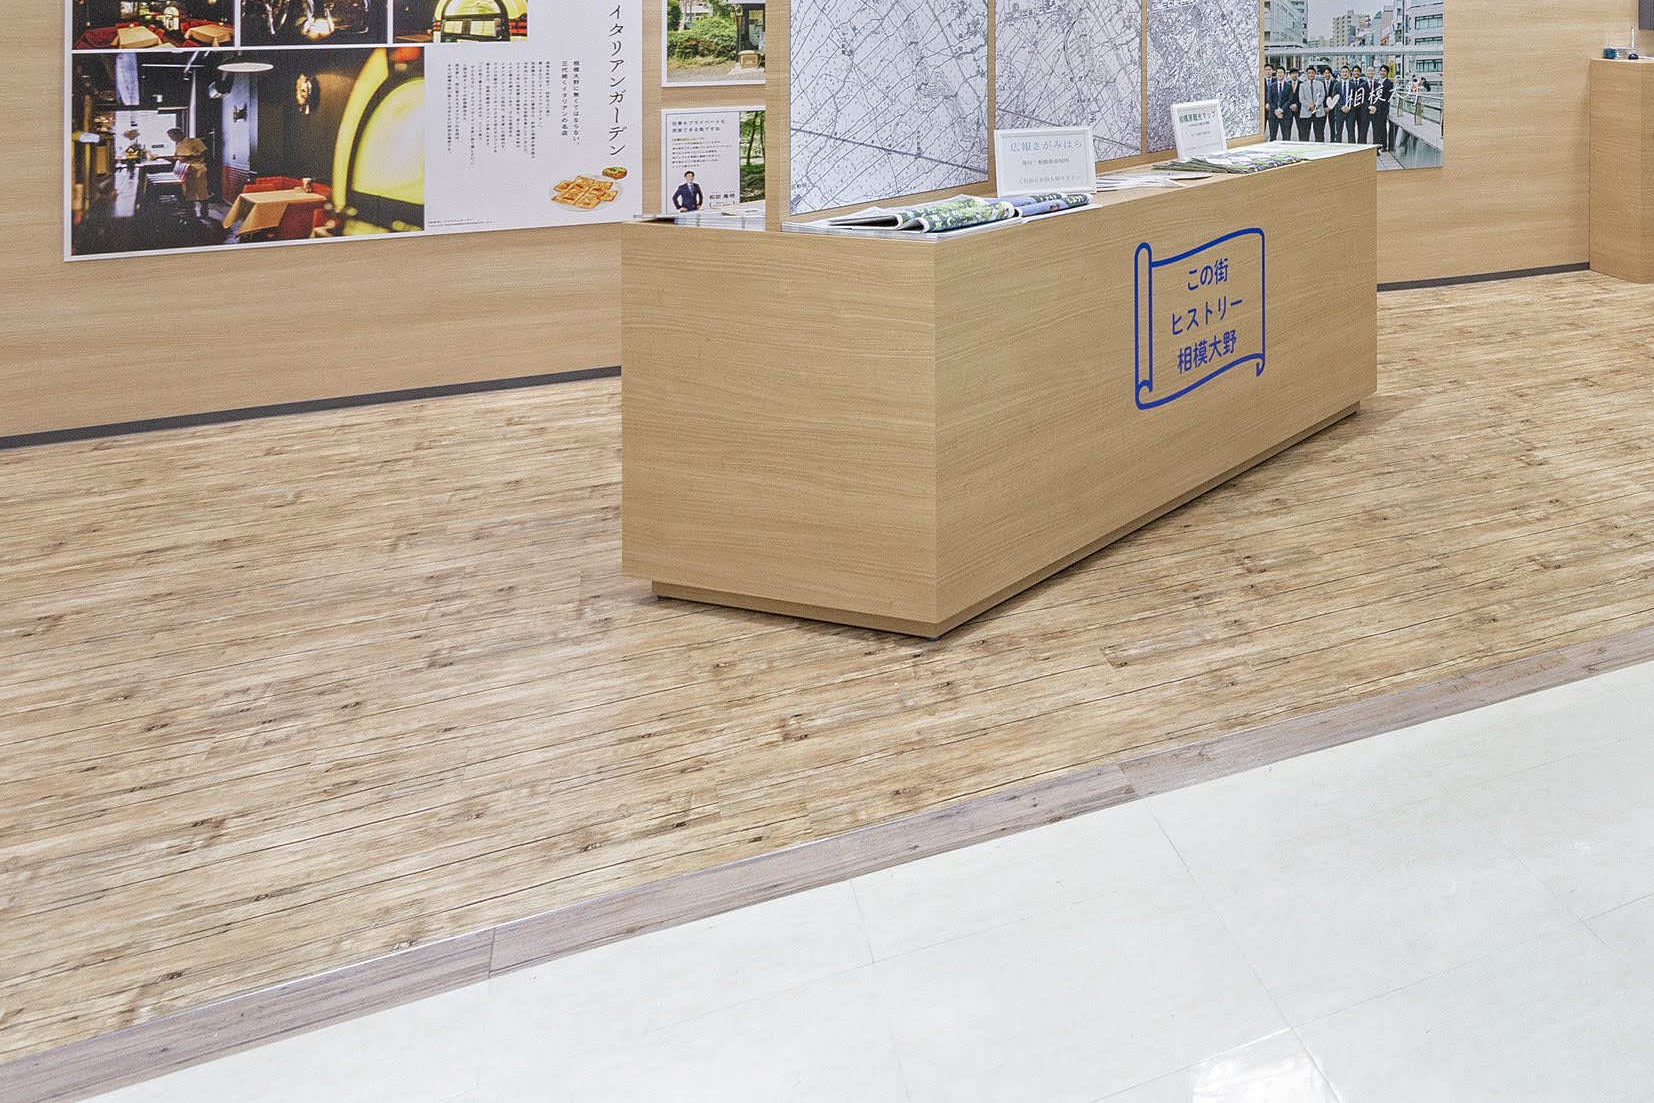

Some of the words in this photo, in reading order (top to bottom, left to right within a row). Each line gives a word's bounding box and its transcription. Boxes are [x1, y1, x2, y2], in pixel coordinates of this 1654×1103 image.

[608, 4, 627, 156] イタリアンガーデン
[1345, 82, 1421, 110] 相模大野
[1009, 139, 1082, 152] 広報さがみはら
[1187, 257, 1229, 291] この街
[1172, 295, 1243, 335] ヒストリー
[1177, 329, 1237, 375] 相模大野
